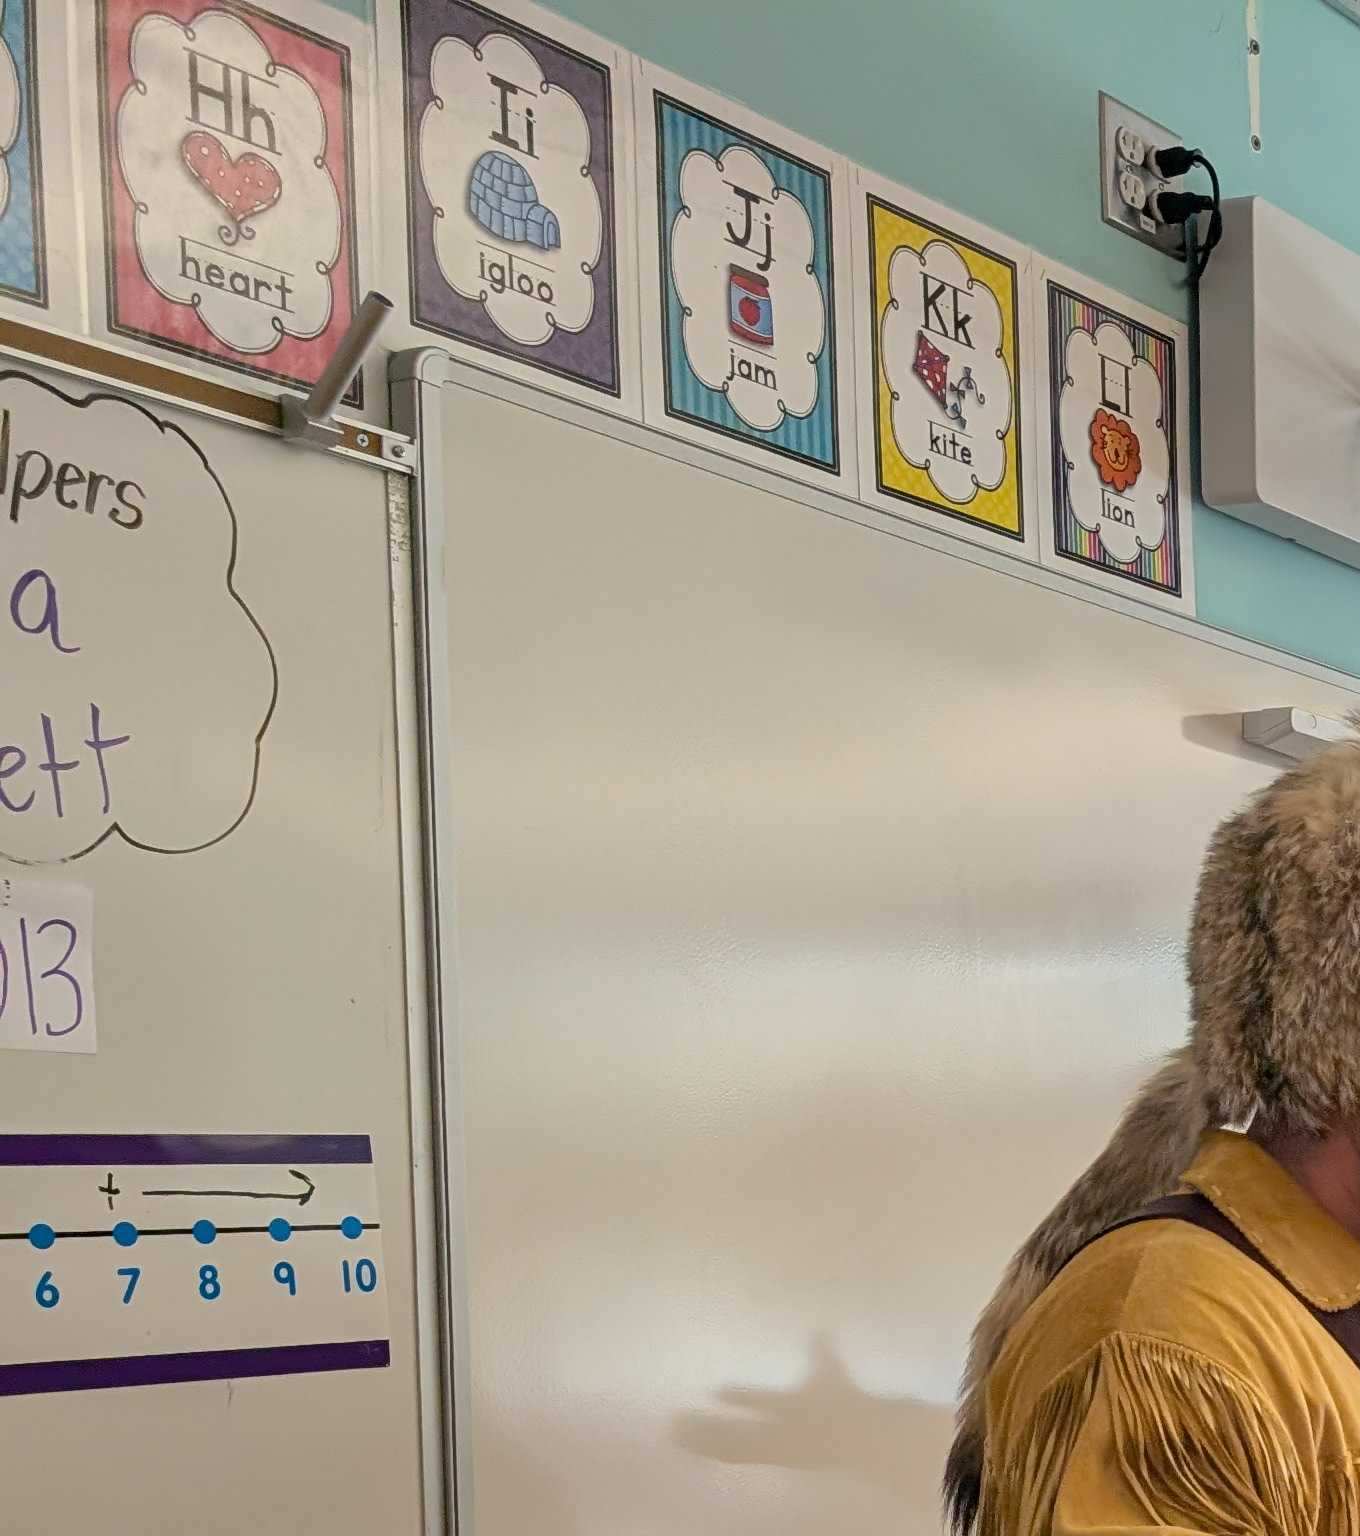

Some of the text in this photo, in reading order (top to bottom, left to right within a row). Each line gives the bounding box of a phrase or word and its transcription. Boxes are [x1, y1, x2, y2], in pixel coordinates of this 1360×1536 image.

[188, 48, 280, 154] Hh
[487, 74, 538, 157] Ii
[727, 184, 775, 272] Jj
[179, 241, 295, 311] heart
[478, 251, 556, 304] igloo
[920, 274, 976, 349] Kk
[726, 349, 779, 391] jam
[927, 422, 974, 467] kite
[1100, 497, 1136, 529] lion
[35, 1258, 378, 1309] 6 7 8 9 10
